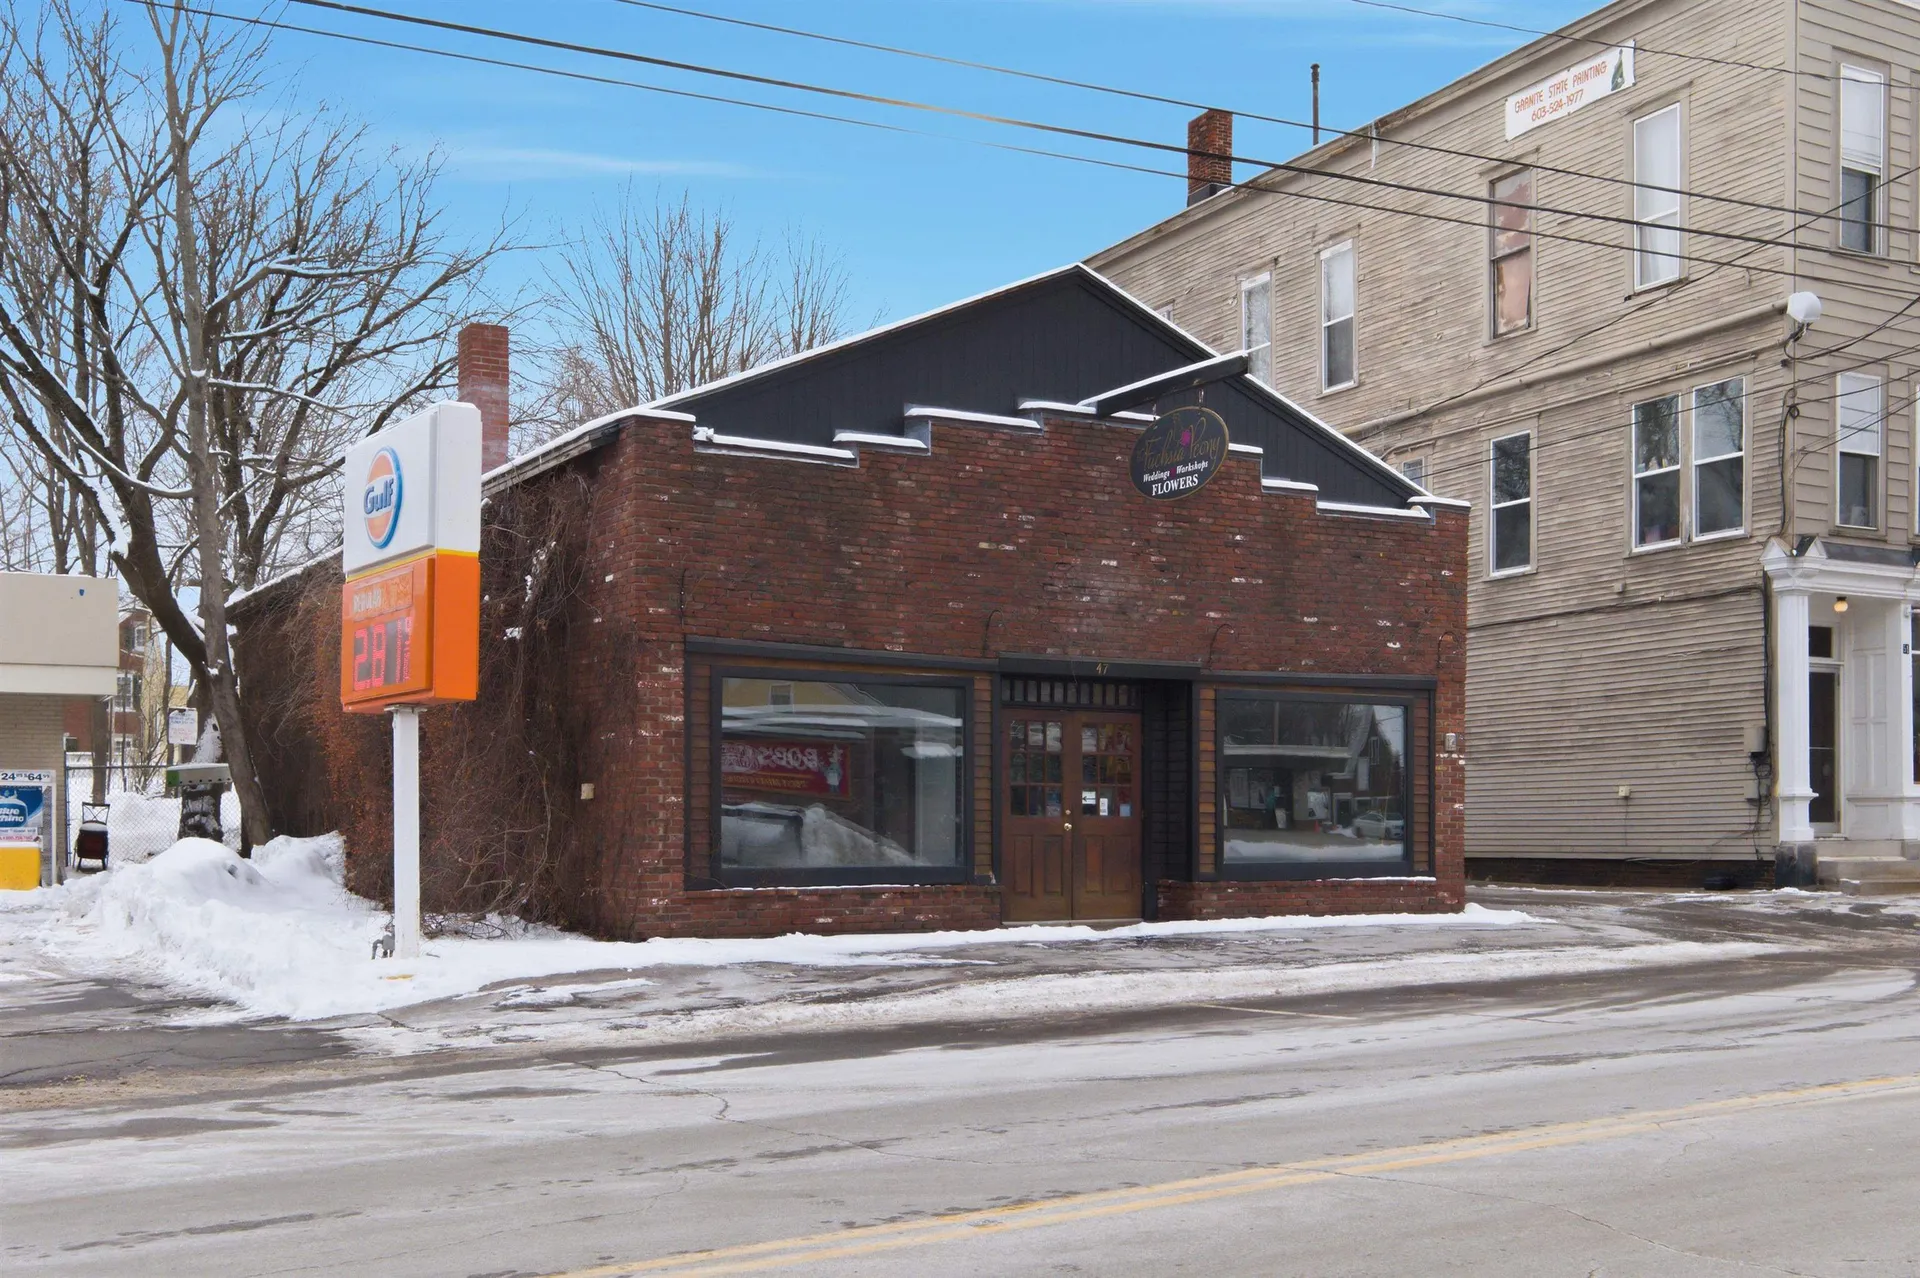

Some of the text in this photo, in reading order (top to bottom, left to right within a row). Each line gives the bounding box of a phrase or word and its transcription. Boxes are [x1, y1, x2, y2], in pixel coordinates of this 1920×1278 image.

[1514, 61, 1608, 114] GRANITE STATE PAINTING
[1531, 89, 1584, 122] 603-524-1977
[1189, 417, 1221, 470] Peony
[1143, 460, 1209, 483] Weddings Workshops
[1151, 474, 1199, 496] FLOWERS
[363, 477, 395, 517] Gulf
[1096, 663, 1109, 676] 47
